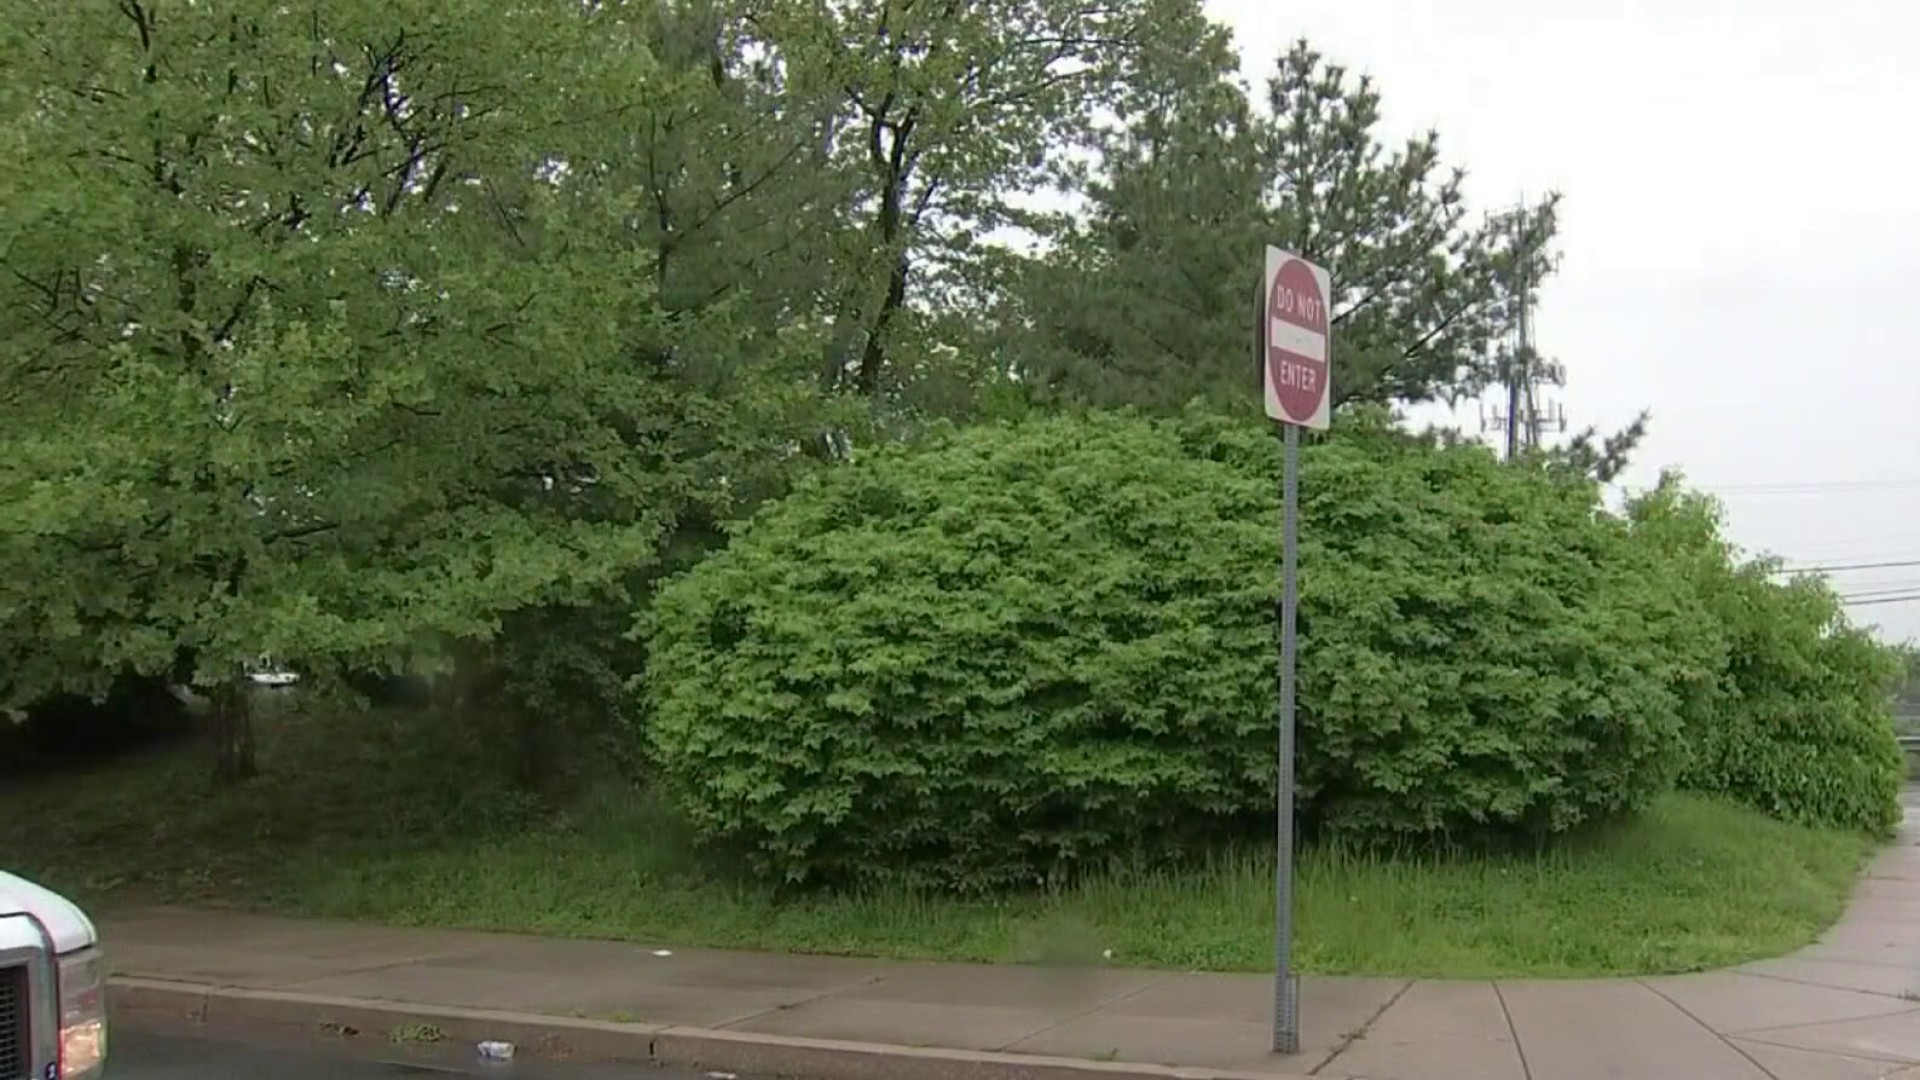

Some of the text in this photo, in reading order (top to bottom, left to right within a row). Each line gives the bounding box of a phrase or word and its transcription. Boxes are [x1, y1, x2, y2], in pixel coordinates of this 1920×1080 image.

[1277, 285, 1321, 323] DO NOT
[1281, 360, 1316, 393] ENTER
